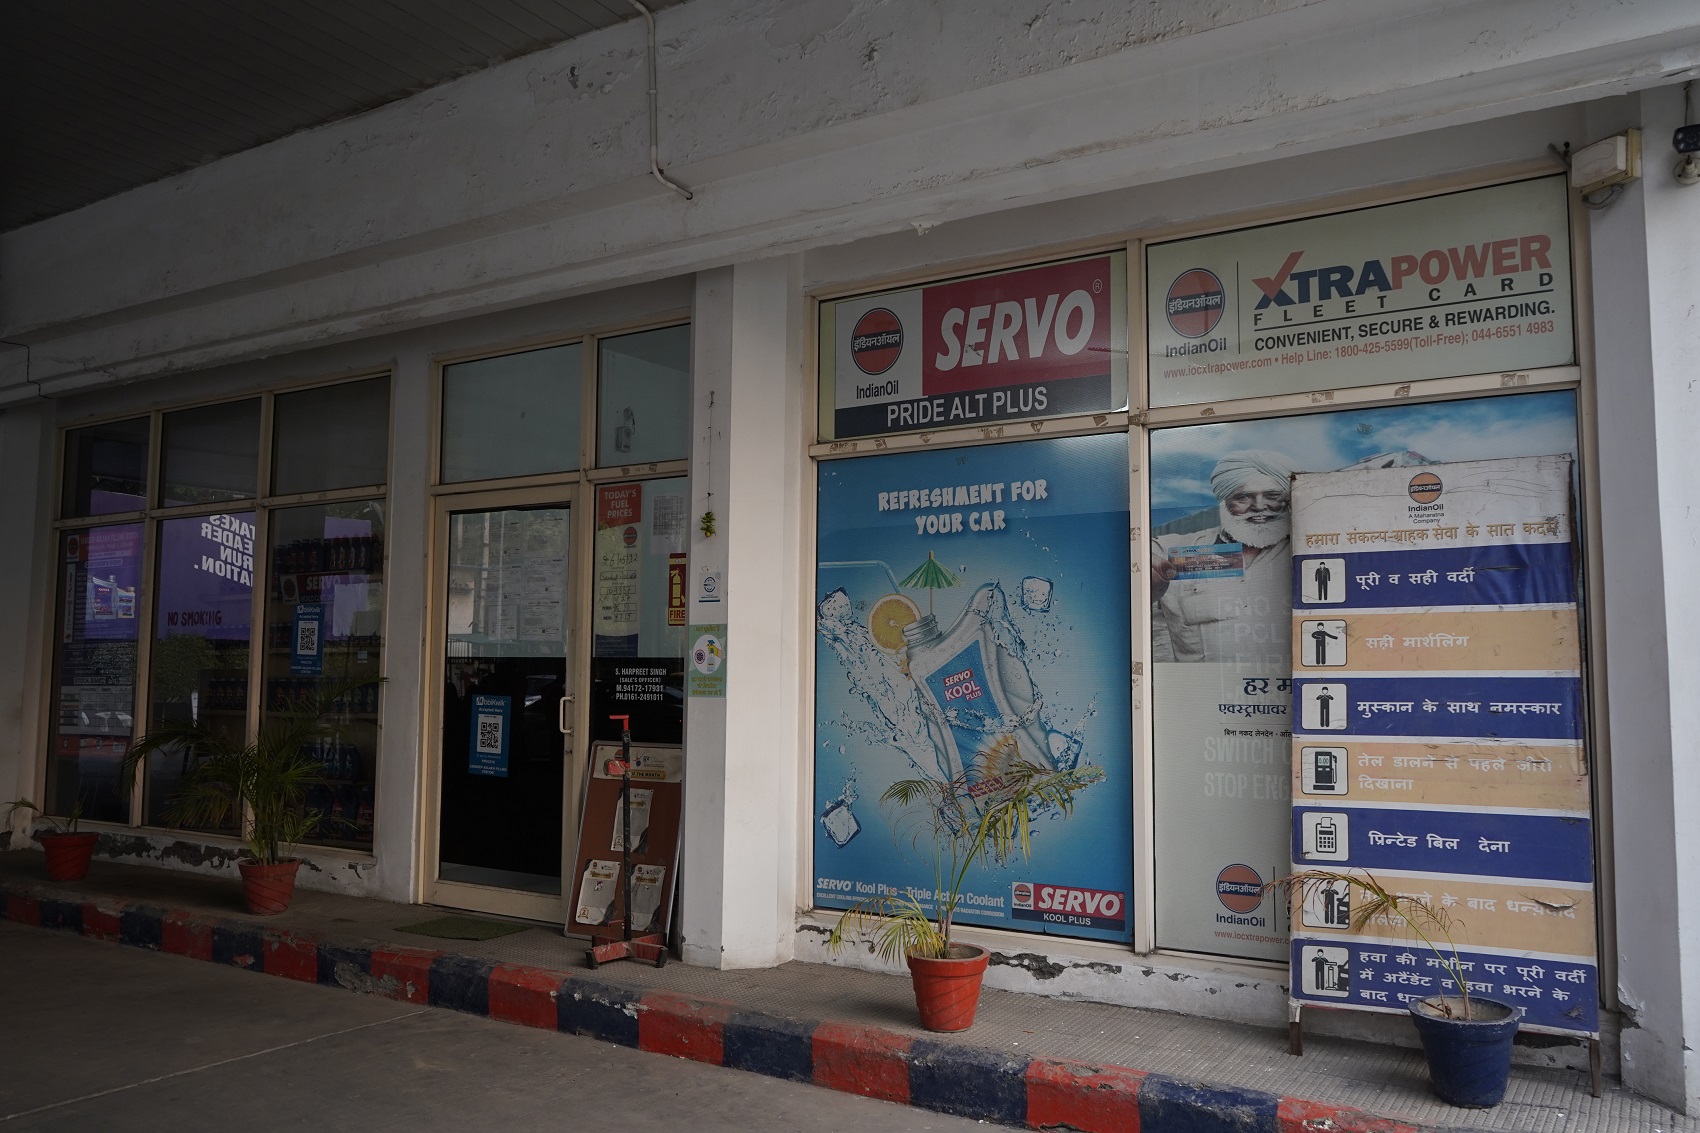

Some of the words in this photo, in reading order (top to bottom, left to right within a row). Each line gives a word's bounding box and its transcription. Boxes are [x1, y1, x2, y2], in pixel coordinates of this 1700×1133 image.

[1252, 234, 1552, 310] XTRAPOWER
[1168, 293, 1222, 313] इंडियनऑयल
[1253, 295, 1388, 326] FLEET
[1428, 272, 1554, 302] CARD
[935, 289, 1095, 371] SERVO
[1254, 325, 1355, 352] CONVENIENT,
[1358, 318, 1424, 339] SECURE
[1428, 314, 1440, 329] &
[1445, 300, 1556, 327] REWARDING.
[854, 332, 900, 352] इंडियनऑयल
[1163, 356, 1272, 379] www.iocxtrapower.com
[1281, 350, 1304, 367] Help
[1306, 347, 1332, 363] Line:
[1471, 325, 1523, 342] 044-6551
[1526, 320, 1554, 335] 4983
[1165, 338, 1227, 358] IndianOil
[856, 381, 899, 399] IndianOil
[887, 396, 945, 427] PRIDE
[949, 392, 987, 419] ALT
[992, 387, 1048, 415] PLUS
[604, 489, 636, 500] TODAY'S
[611, 499, 629, 508] FUEL
[877, 483, 1005, 512] REFRESHMENT
[1011, 479, 1048, 502] FOR
[607, 508, 633, 518] PRICES
[1408, 503, 1444, 513] IndianOil
[915, 513, 963, 535] YOUR
[969, 510, 1006, 531] CAR
[1306, 532, 1340, 548] हमारा
[1346, 528, 1429, 544] संकल्प-ग्राहक
[1432, 523, 1459, 541] सेवा
[1466, 521, 1480, 538] के
[1487, 523, 1516, 537] सात
[1355, 571, 1380, 590] पूरी
[1388, 574, 1401, 585] व
[1408, 570, 1439, 584] सही
[1447, 567, 1475, 583] वर्दी
[168, 612, 178, 626] NO
[669, 610, 685, 618] FIRE
[1234, 623, 1286, 643] POL
[1365, 635, 1395, 650] सही
[1403, 632, 1470, 648] मार्शलिंग
[615, 667, 621, 675] S.
[621, 667, 649, 676] HARPREET
[649, 668, 667, 676] SINGH
[1236, 653, 1284, 674] FIR
[945, 670, 971, 686] SERVO
[1243, 678, 1270, 696] हर
[1276, 678, 1293, 695] म
[945, 680, 980, 701] KOOL
[966, 690, 982, 700] PLUS
[1357, 701, 1415, 718] मुस्कान
[1422, 698, 1440, 713] के
[1447, 701, 1481, 714] साथ
[1490, 702, 1563, 715] नमस्कार
[1224, 728, 1237, 736] बिना
[1255, 729, 1273, 737] लेनदेन
[1206, 737, 1273, 764] SWITCH
[1358, 752, 1384, 768] तेल
[1393, 754, 1435, 769] डालने
[1445, 753, 1459, 770] से
[1469, 755, 1507, 773] पहले
[1206, 773, 1248, 797] STOP
[1253, 775, 1291, 801] ENG
[1358, 777, 1414, 791] दिखाना
[1368, 830, 1418, 848] प्रिन्टेड
[1426, 833, 1460, 850] बिल
[1478, 837, 1510, 853] देना
[816, 878, 852, 891] SERVO
[856, 882, 875, 894] Kool
[878, 883, 898, 896] Plus
[906, 887, 931, 900] Triple
[967, 893, 1004, 908] Coolant
[1038, 887, 1120, 916] SERVO
[1441, 893, 1458, 907] के
[1467, 898, 1497, 912] बाद
[1043, 913, 1067, 923] KOOL
[1068, 916, 1091, 926] PLUS
[1216, 913, 1265, 927] IndianOil
[1214, 930, 1290, 945] www.iocxtrapower.c
[1359, 951, 1387, 963] हवा
[1396, 951, 1417, 966] की
[1426, 956, 1475, 972] मशीन
[1484, 963, 1507, 975] पर
[1517, 964, 1545, 982] पूरी
[1555, 969, 1587, 984] वर्दी
[1359, 968, 1375, 981] में
[1441, 978, 1454, 989] व
[1465, 981, 1494, 994] हवा
[1503, 983, 1543, 999] भरने
[1552, 987, 1571, 1002] के
[1359, 989, 1389, 1001] बाद
